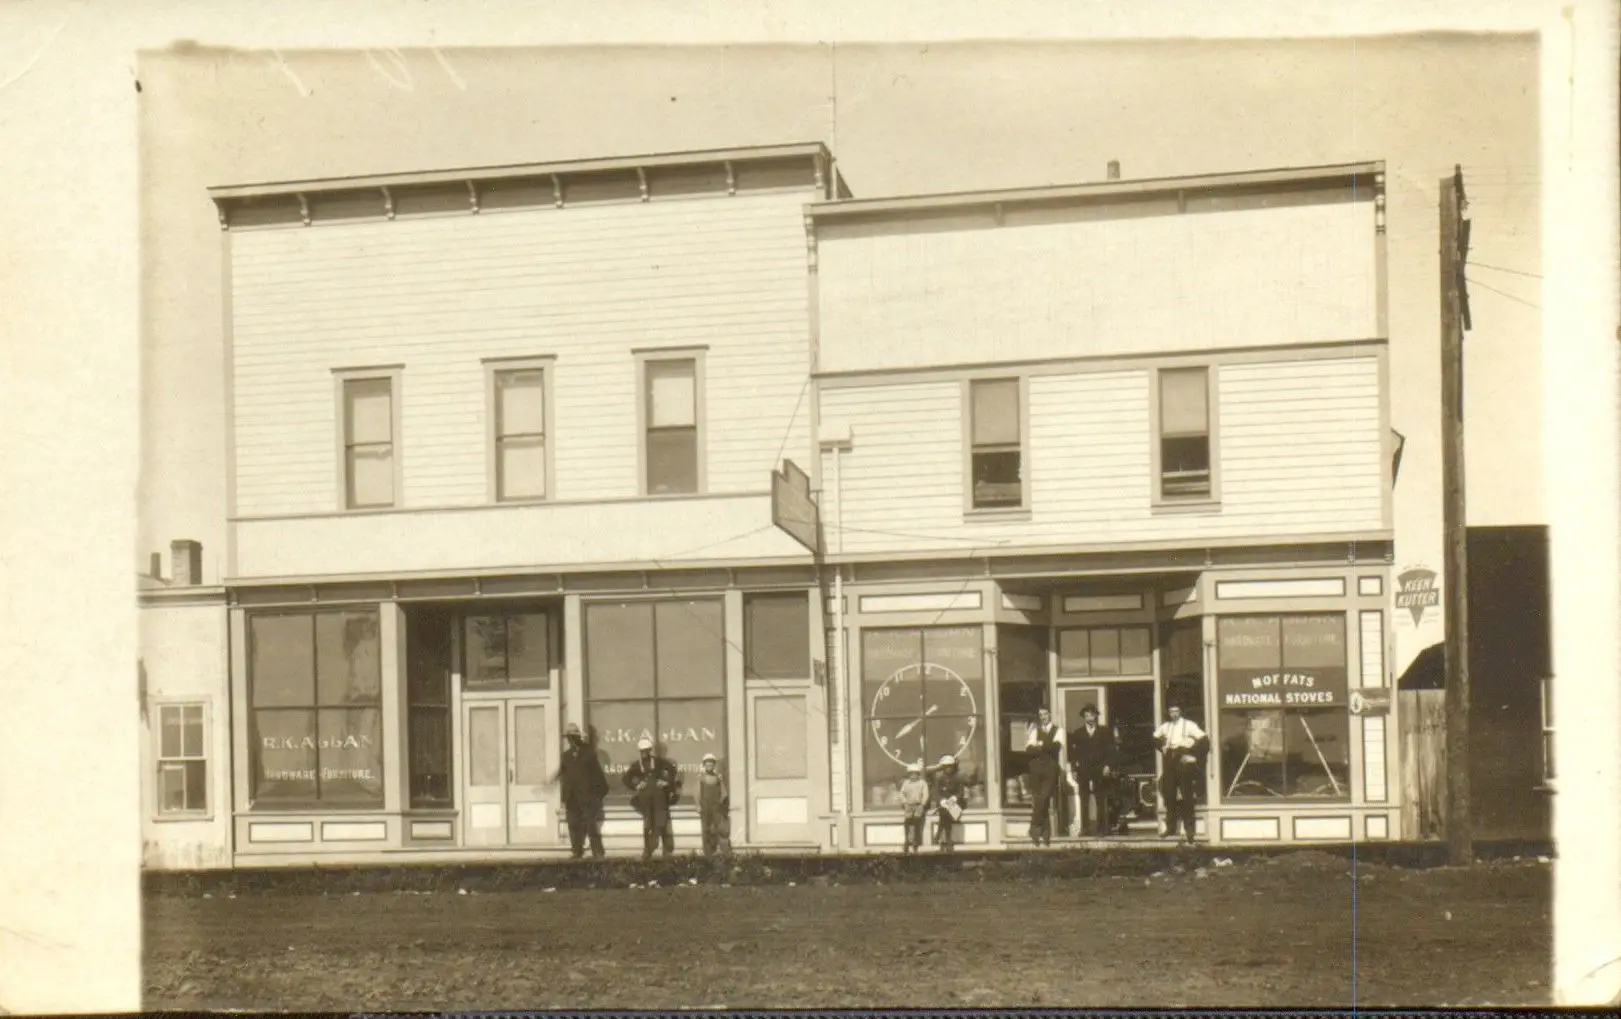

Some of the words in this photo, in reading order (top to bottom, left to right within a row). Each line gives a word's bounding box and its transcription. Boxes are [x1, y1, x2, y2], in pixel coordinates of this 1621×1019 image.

[1404, 579, 1430, 592] KEEN
[1397, 592, 1436, 608] KUTTER
[1225, 692, 1282, 705] NATIONAL
[1286, 691, 1334, 704] STOVES
